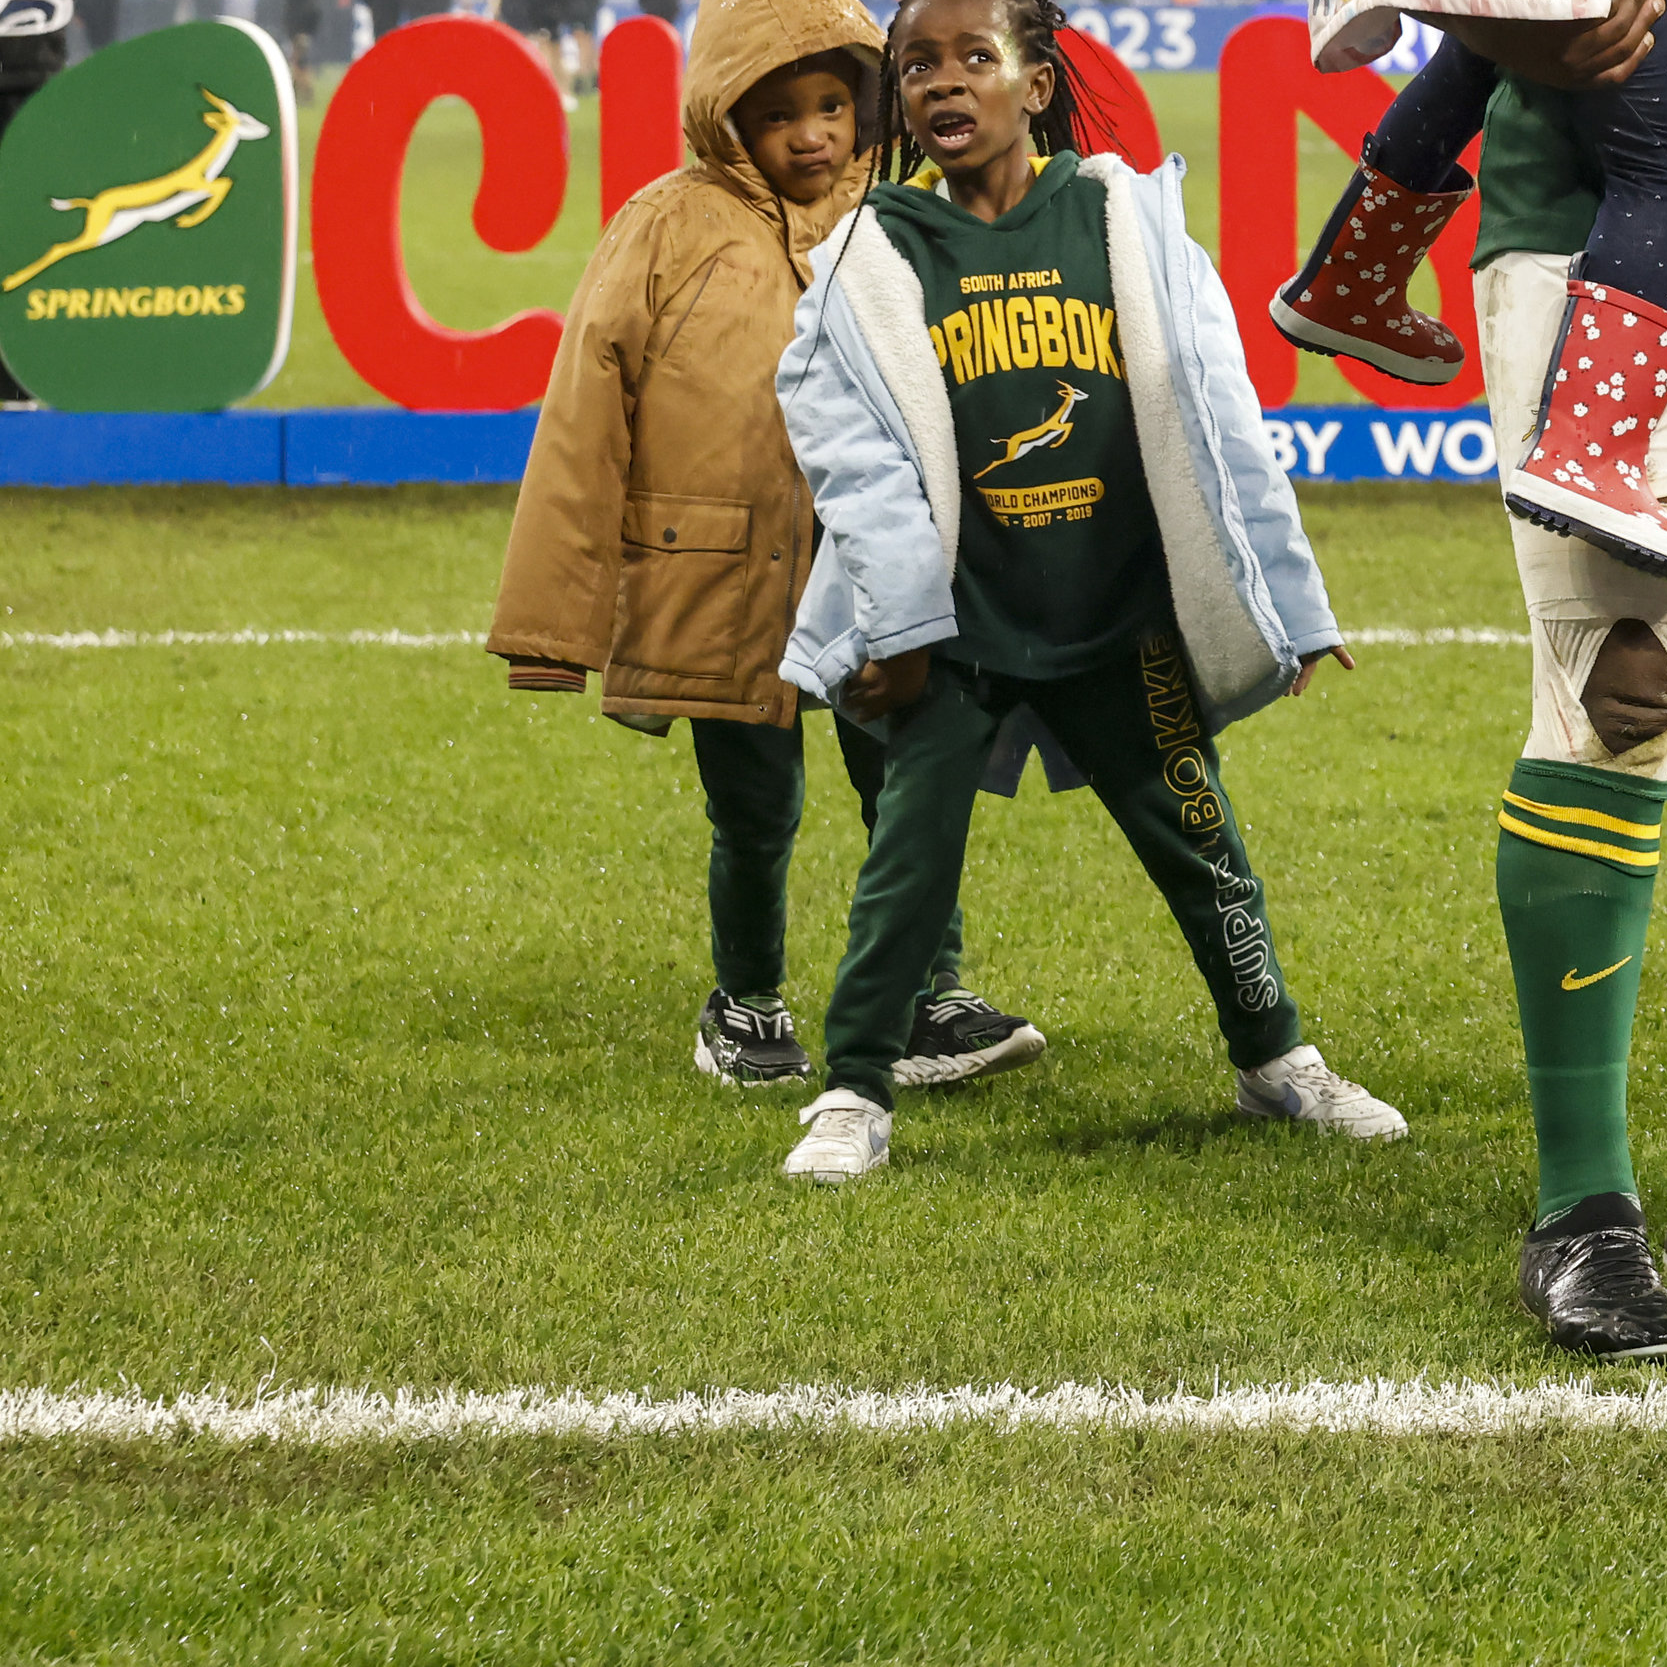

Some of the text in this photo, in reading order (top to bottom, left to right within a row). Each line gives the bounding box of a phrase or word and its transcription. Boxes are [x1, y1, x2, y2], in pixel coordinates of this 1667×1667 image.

[960, 268, 1062, 294] SOUTH AFRICA
[26, 284, 247, 322] SPRINGBOKS
[929, 295, 1127, 385] PRINGBOK
[987, 483, 1098, 509] ORLD CHAMPIONS
[1022, 512, 1052, 529] 2007
[1066, 505, 1093, 522] 2019
